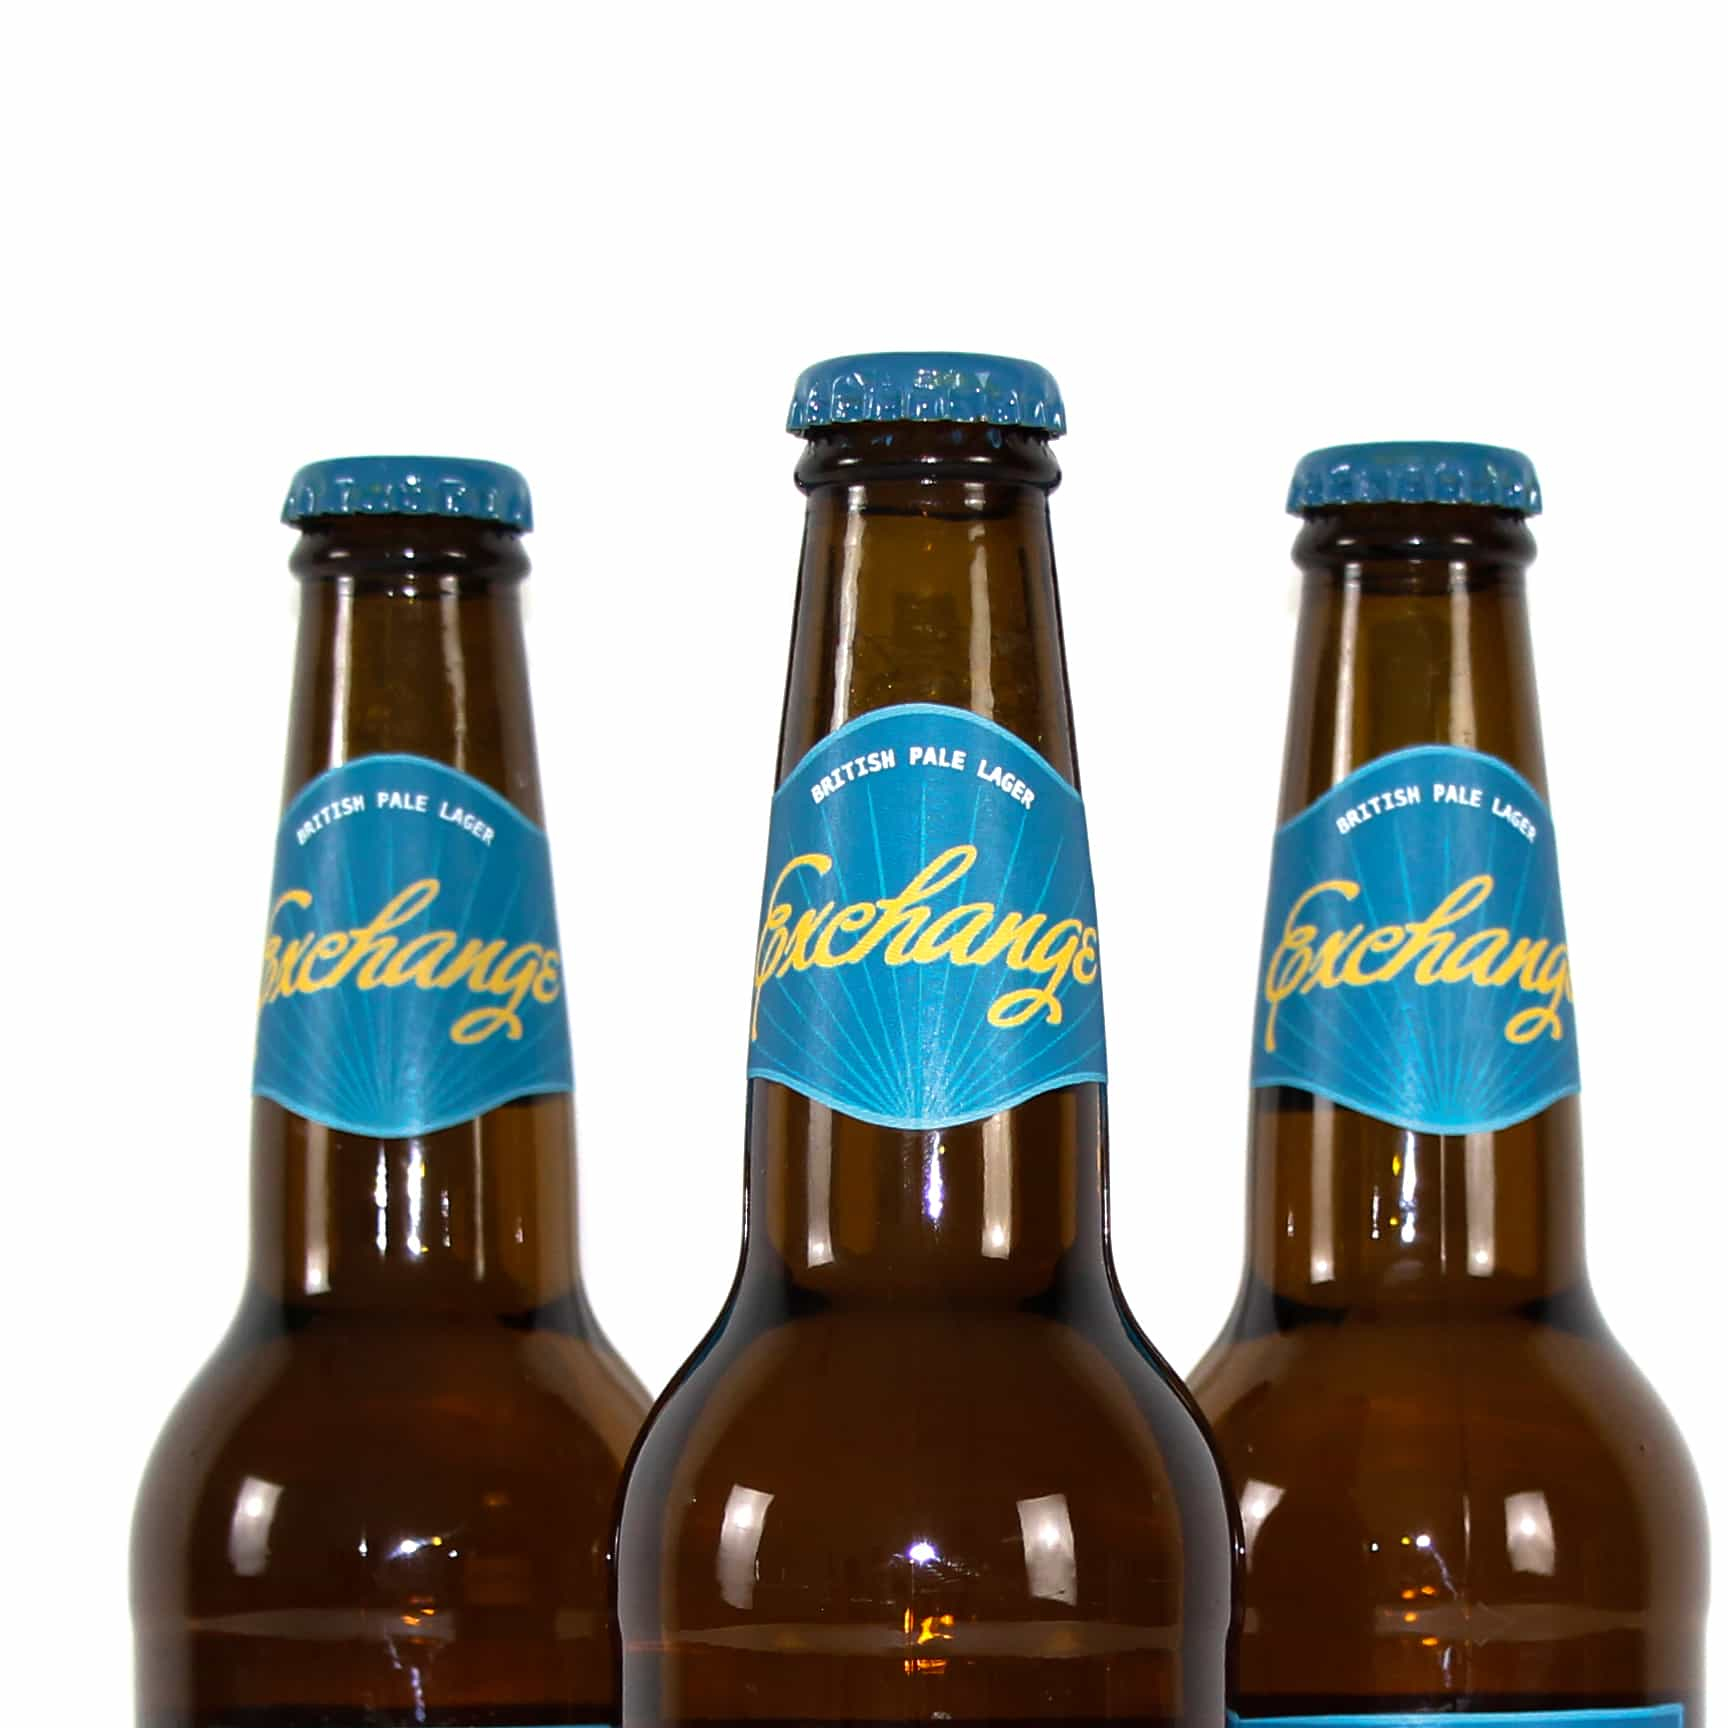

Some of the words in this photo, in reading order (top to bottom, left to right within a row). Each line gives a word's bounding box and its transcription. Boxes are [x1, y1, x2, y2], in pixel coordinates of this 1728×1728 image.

[810, 748, 896, 804] BRITISH
[909, 746, 967, 771] PALE
[976, 758, 1035, 810] LAGER
[296, 794, 365, 845] BRITISH
[377, 791, 428, 812] PALE
[439, 801, 494, 844] LAGER
[1335, 785, 1422, 836] BRITISH
[1433, 783, 1483, 808] PALE
[1491, 797, 1537, 842] LAGER
[748, 843, 1098, 1042] Exchange
[1264, 874, 1574, 1054] Exchang
